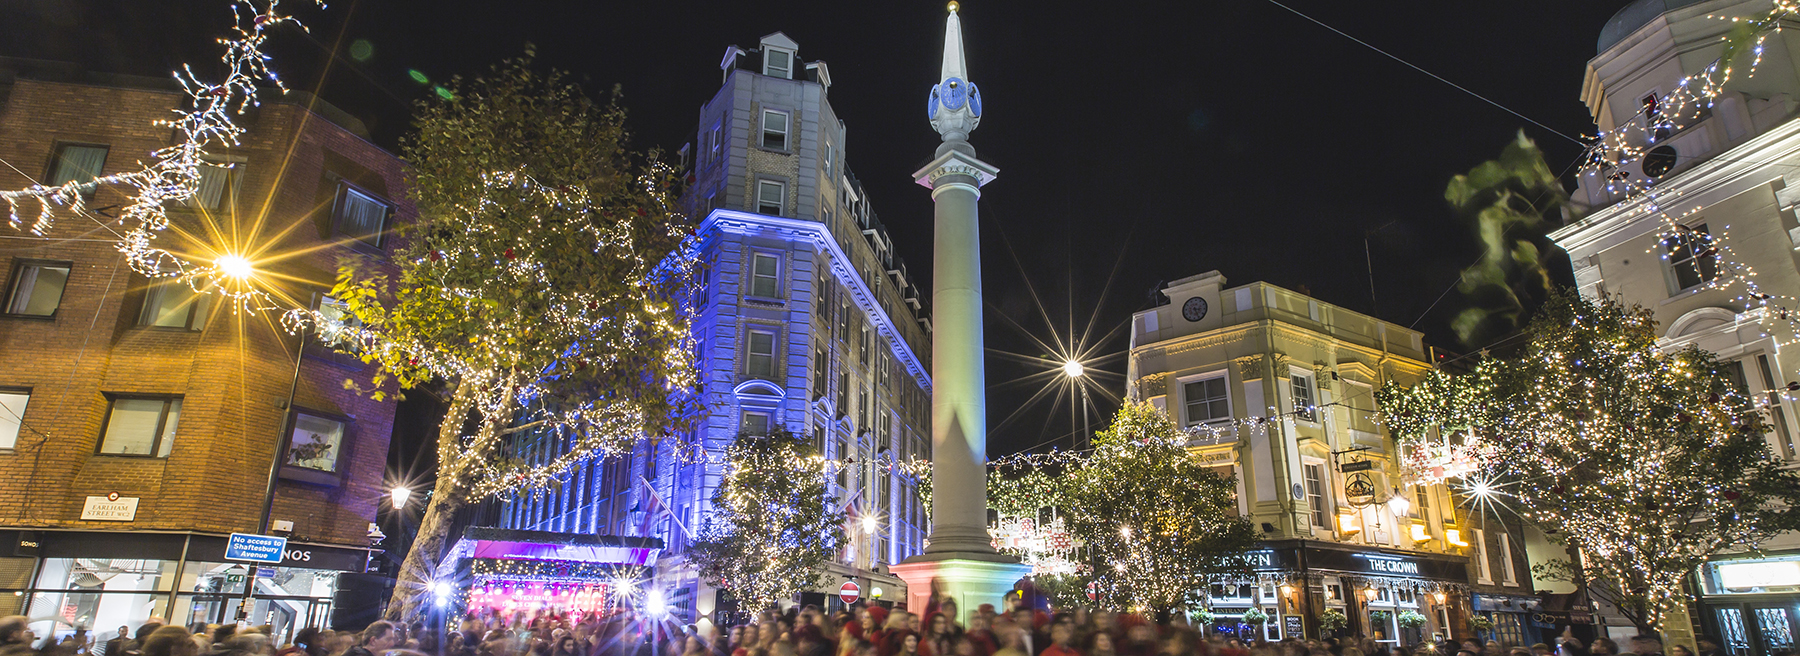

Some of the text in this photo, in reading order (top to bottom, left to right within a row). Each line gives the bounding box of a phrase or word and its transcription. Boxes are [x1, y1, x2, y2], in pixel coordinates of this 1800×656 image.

[246, 538, 272, 546] access
[233, 543, 279, 554] Shaftesbury
[240, 550, 268, 559] Avenue
[284, 550, 311, 561] NOS
[1369, 559, 1419, 574] THE CROWN
